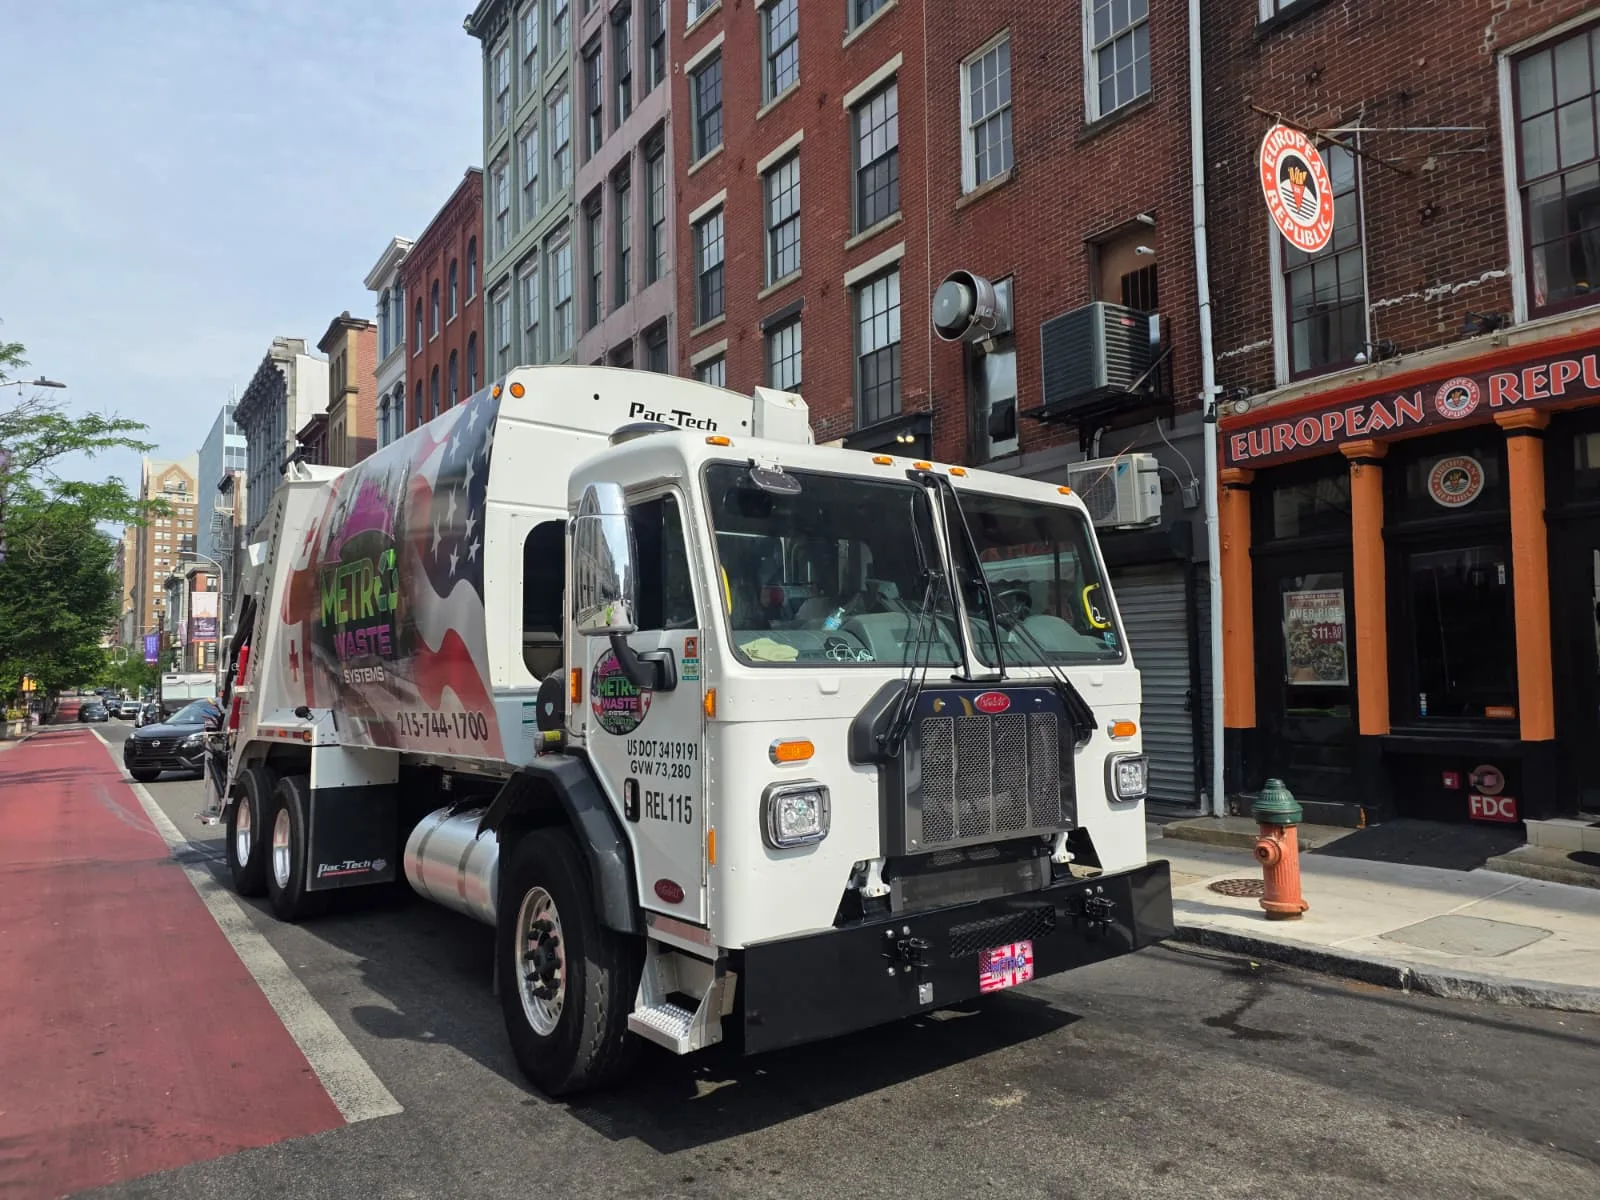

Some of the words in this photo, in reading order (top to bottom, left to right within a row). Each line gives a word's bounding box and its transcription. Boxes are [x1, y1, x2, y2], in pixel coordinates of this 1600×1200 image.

[1264, 129, 1330, 194] EUROPEAN
[1267, 189, 1330, 246] REPUBLIC
[629, 401, 718, 432] Pac-Tech
[1230, 391, 1425, 462] EUROPEAN
[1290, 608, 1314, 619] OVER
[333, 624, 392, 662] WASTE
[343, 667, 385, 684] SYSTEMS
[602, 697, 638, 710] WASTE
[397, 711, 489, 741] 215-744-1700
[659, 741, 698, 761] 3419191
[631, 760, 653, 776] GVW
[655, 761, 691, 780] 73,280
[645, 790, 692, 824] REL115
[1471, 795, 1514, 818] FDC
[317, 860, 371, 878] Pac-Tech
